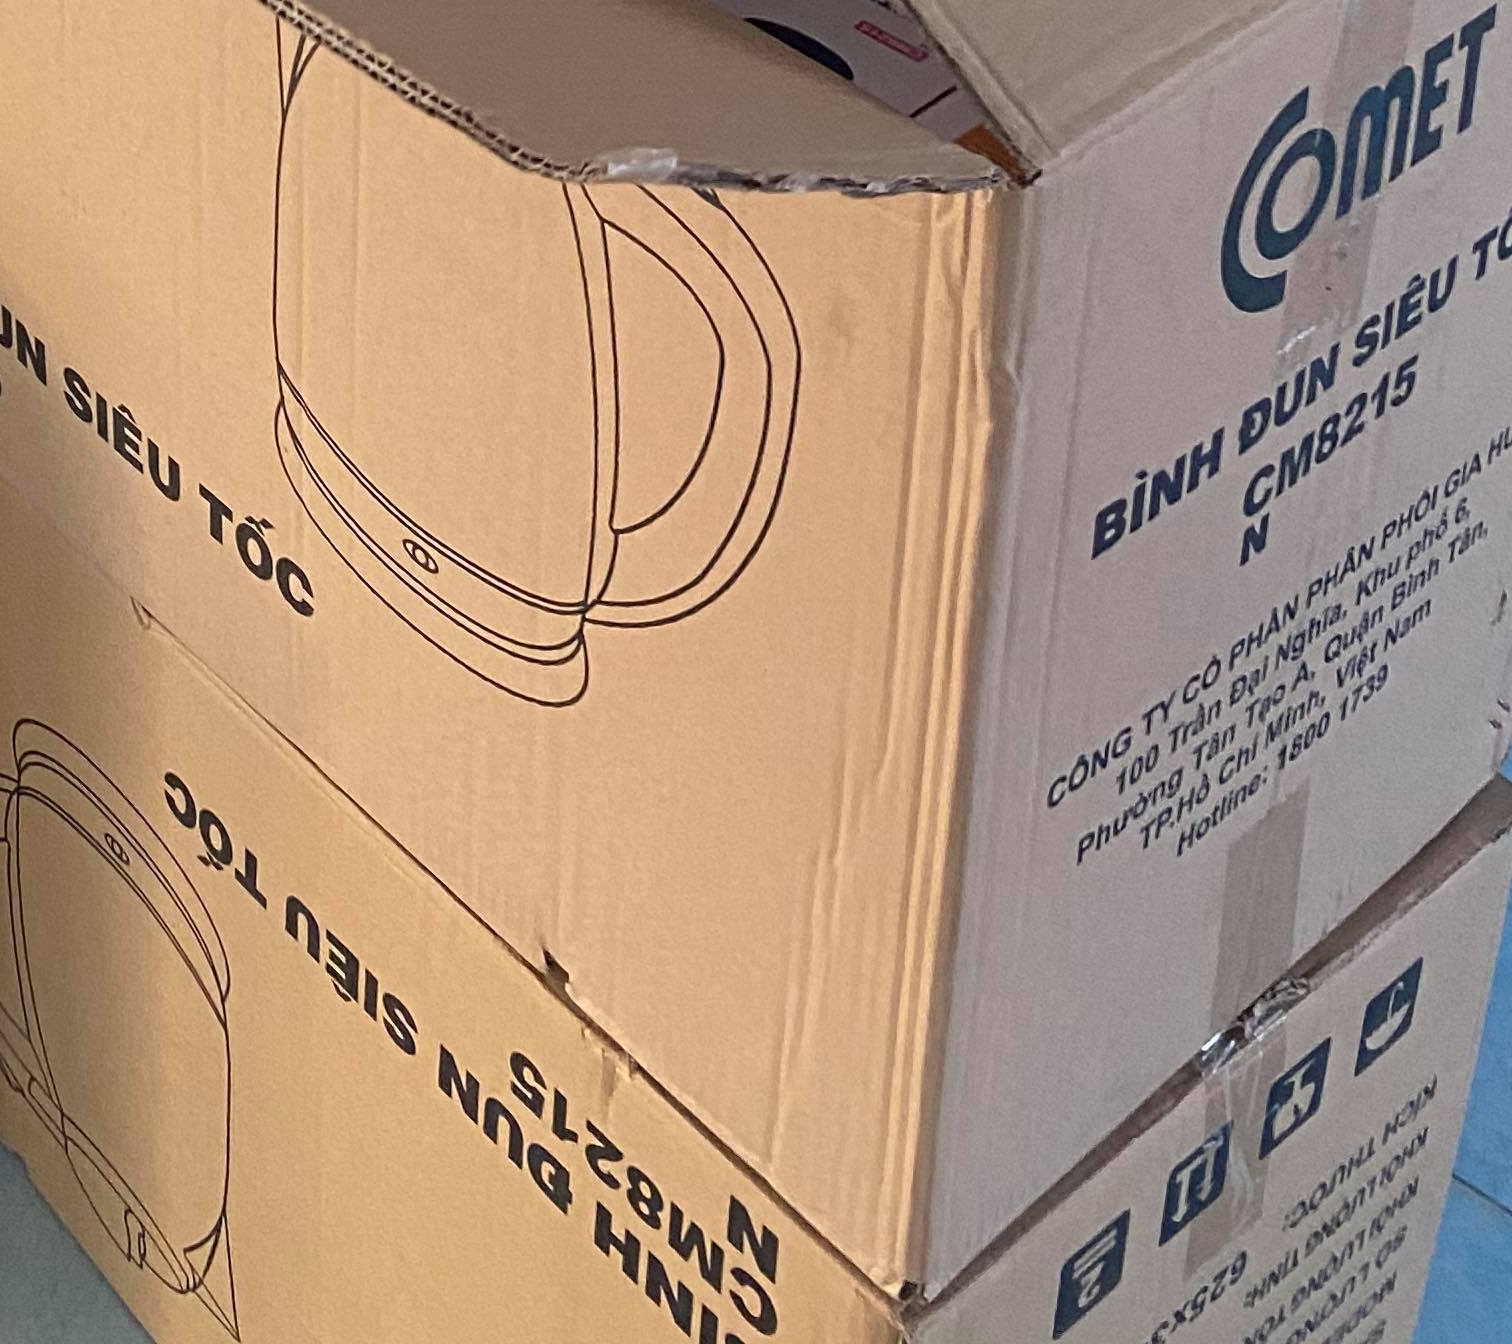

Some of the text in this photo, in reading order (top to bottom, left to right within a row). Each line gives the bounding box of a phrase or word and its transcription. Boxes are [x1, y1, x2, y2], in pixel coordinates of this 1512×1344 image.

[1220, 4, 1496, 313] COMET
[62, 366, 180, 501] SIÊU
[198, 484, 314, 616] TỐC
[1091, 254, 1458, 560] BÌNH ĐUN SIÊU
[1240, 512, 1270, 566] N
[1244, 355, 1420, 517] CM8215
[1047, 726, 1133, 809] CÔNG
[1141, 691, 1177, 736] TY
[1443, 451, 1482, 499] GIA
[1177, 664, 1388, 857] Hotline: 1800 1739
[163, 772, 574, 1214] ĐUN SIÊU TỐC
[507, 1050, 780, 1338] CM8215
[726, 1195, 780, 1278] N
